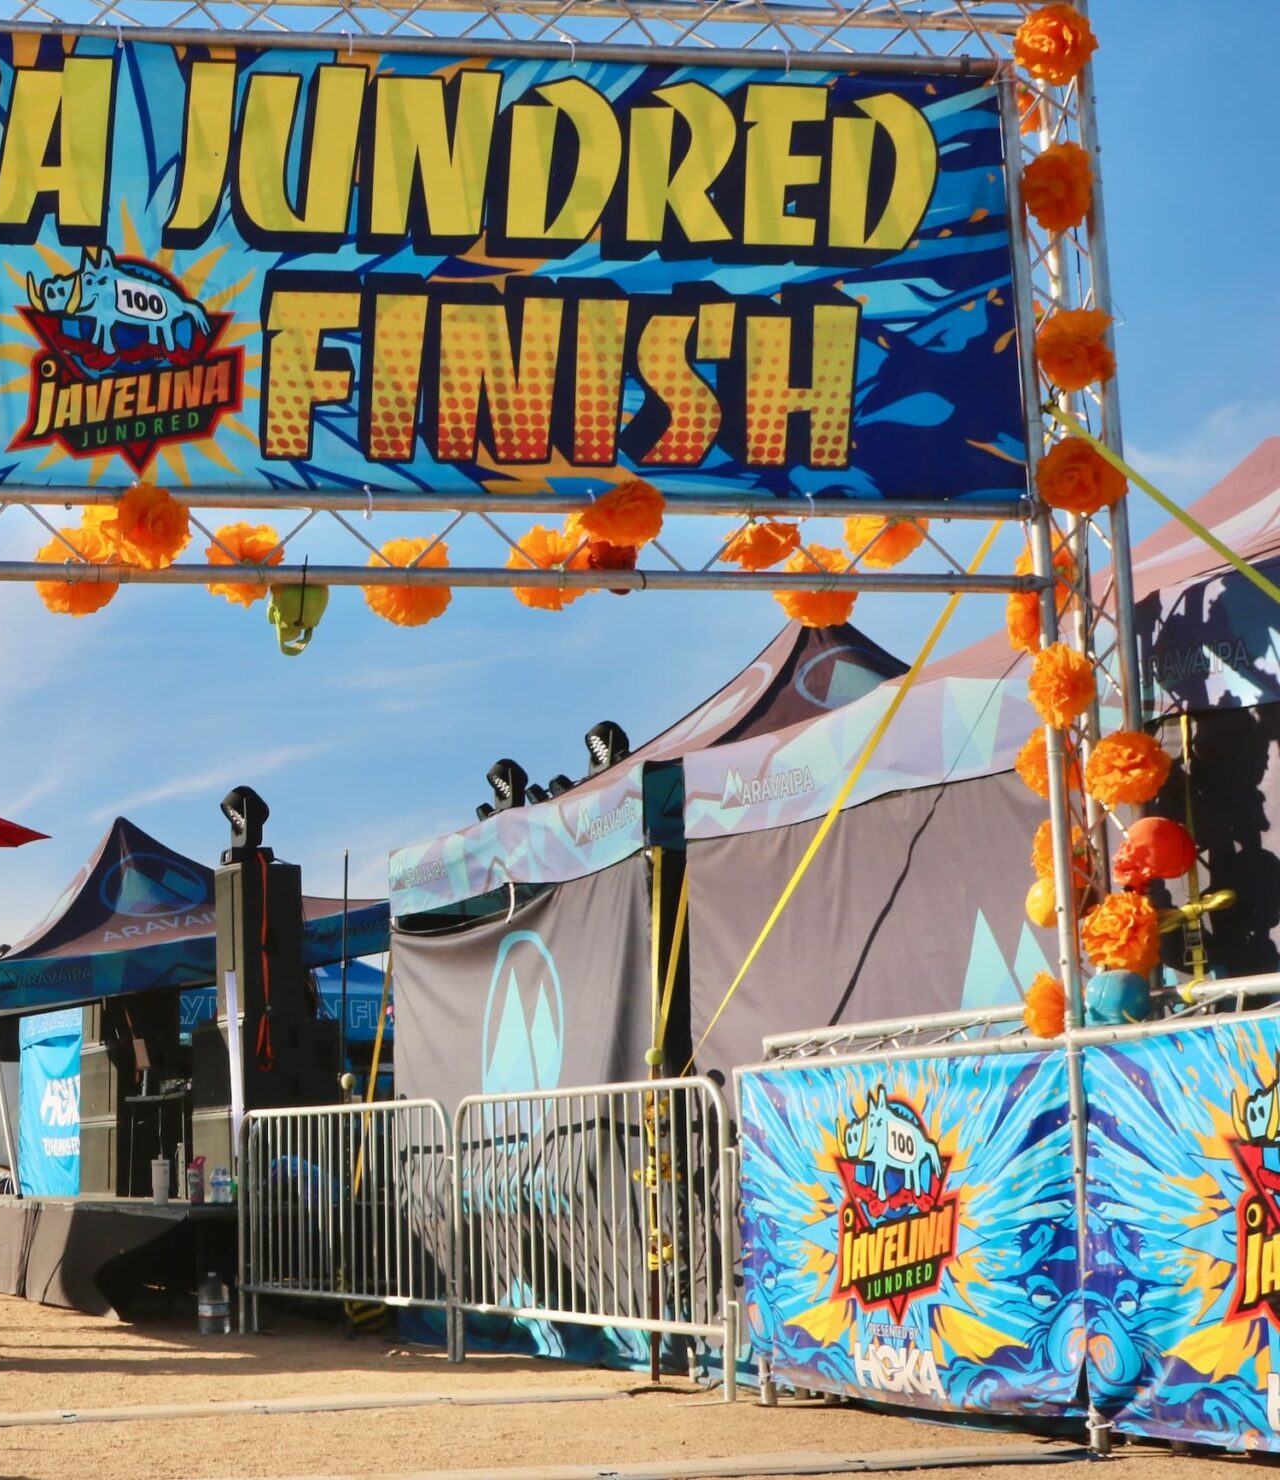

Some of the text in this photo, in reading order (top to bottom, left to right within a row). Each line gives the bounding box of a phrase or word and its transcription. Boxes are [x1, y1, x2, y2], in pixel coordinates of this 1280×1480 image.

[173, 62, 938, 250] JUNDRED
[122, 289, 164, 315] 100
[33, 360, 231, 436] JAVELINA
[265, 291, 862, 467] FINISH
[82, 412, 200, 447] JUNDRED
[1147, 637, 1251, 682] RAVAIPA
[742, 766, 815, 804] ARAVAIPA
[588, 800, 638, 842] ARAVAIPA
[404, 861, 448, 889] ARAVAIPA
[18, 968, 93, 990] ARAVAIPA
[891, 1131, 915, 1156] 100
[841, 1205, 953, 1288] JAVELINA
[867, 1263, 933, 1300] JUNDRED
[869, 1323, 919, 1339] PRESENTED BY
[855, 1343, 946, 1400] HOKA
